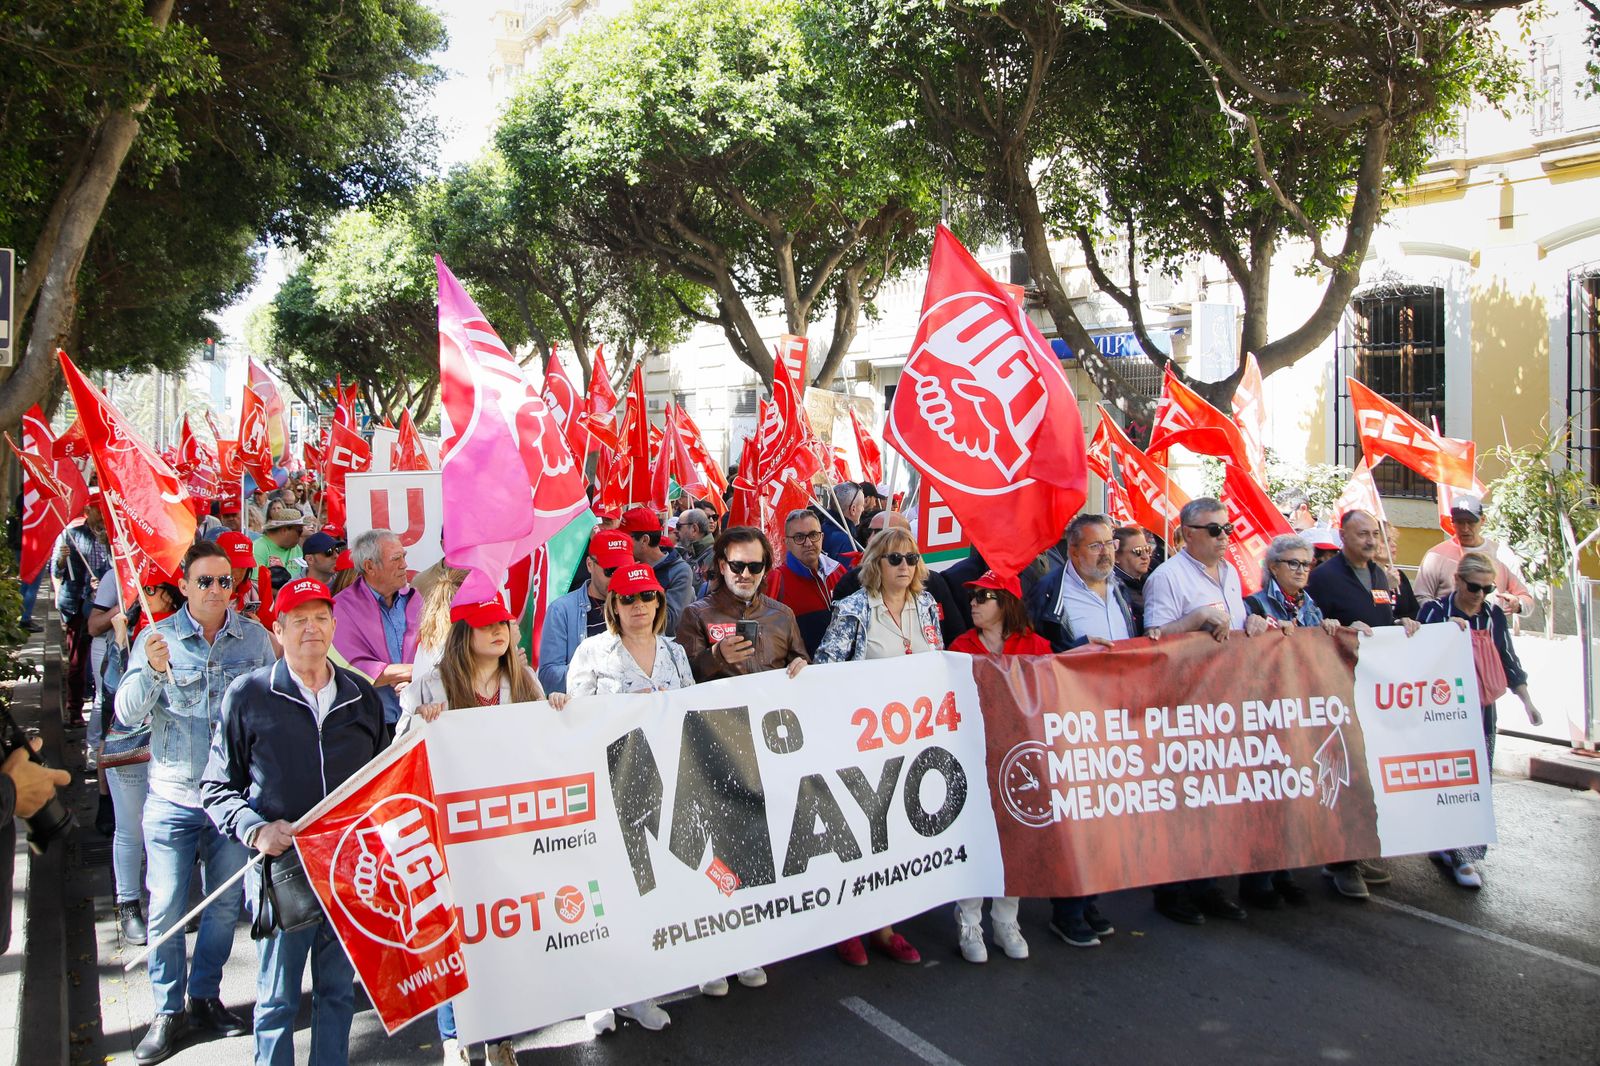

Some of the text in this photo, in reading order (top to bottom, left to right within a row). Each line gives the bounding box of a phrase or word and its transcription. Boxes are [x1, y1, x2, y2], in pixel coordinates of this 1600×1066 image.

[1375, 681, 1427, 710] UGT
[1424, 707, 1467, 722] Almería
[850, 690, 962, 752] 2024
[1043, 695, 1351, 746] POR EL PLENO EMPLEO:
[1047, 744, 1144, 784] MENOS
[1384, 758, 1456, 786] CCOO
[447, 788, 563, 834] CCOO
[1050, 766, 1316, 823] MEJORES SALARIOS
[1437, 790, 1480, 805] Almería
[532, 829, 598, 856] Almería
[381, 807, 454, 926] UGT
[454, 892, 545, 945] UGT
[652, 887, 831, 950] #PLENOEMPLEO
[852, 845, 968, 897] #1MAYO2024
[545, 922, 610, 952] Almería
